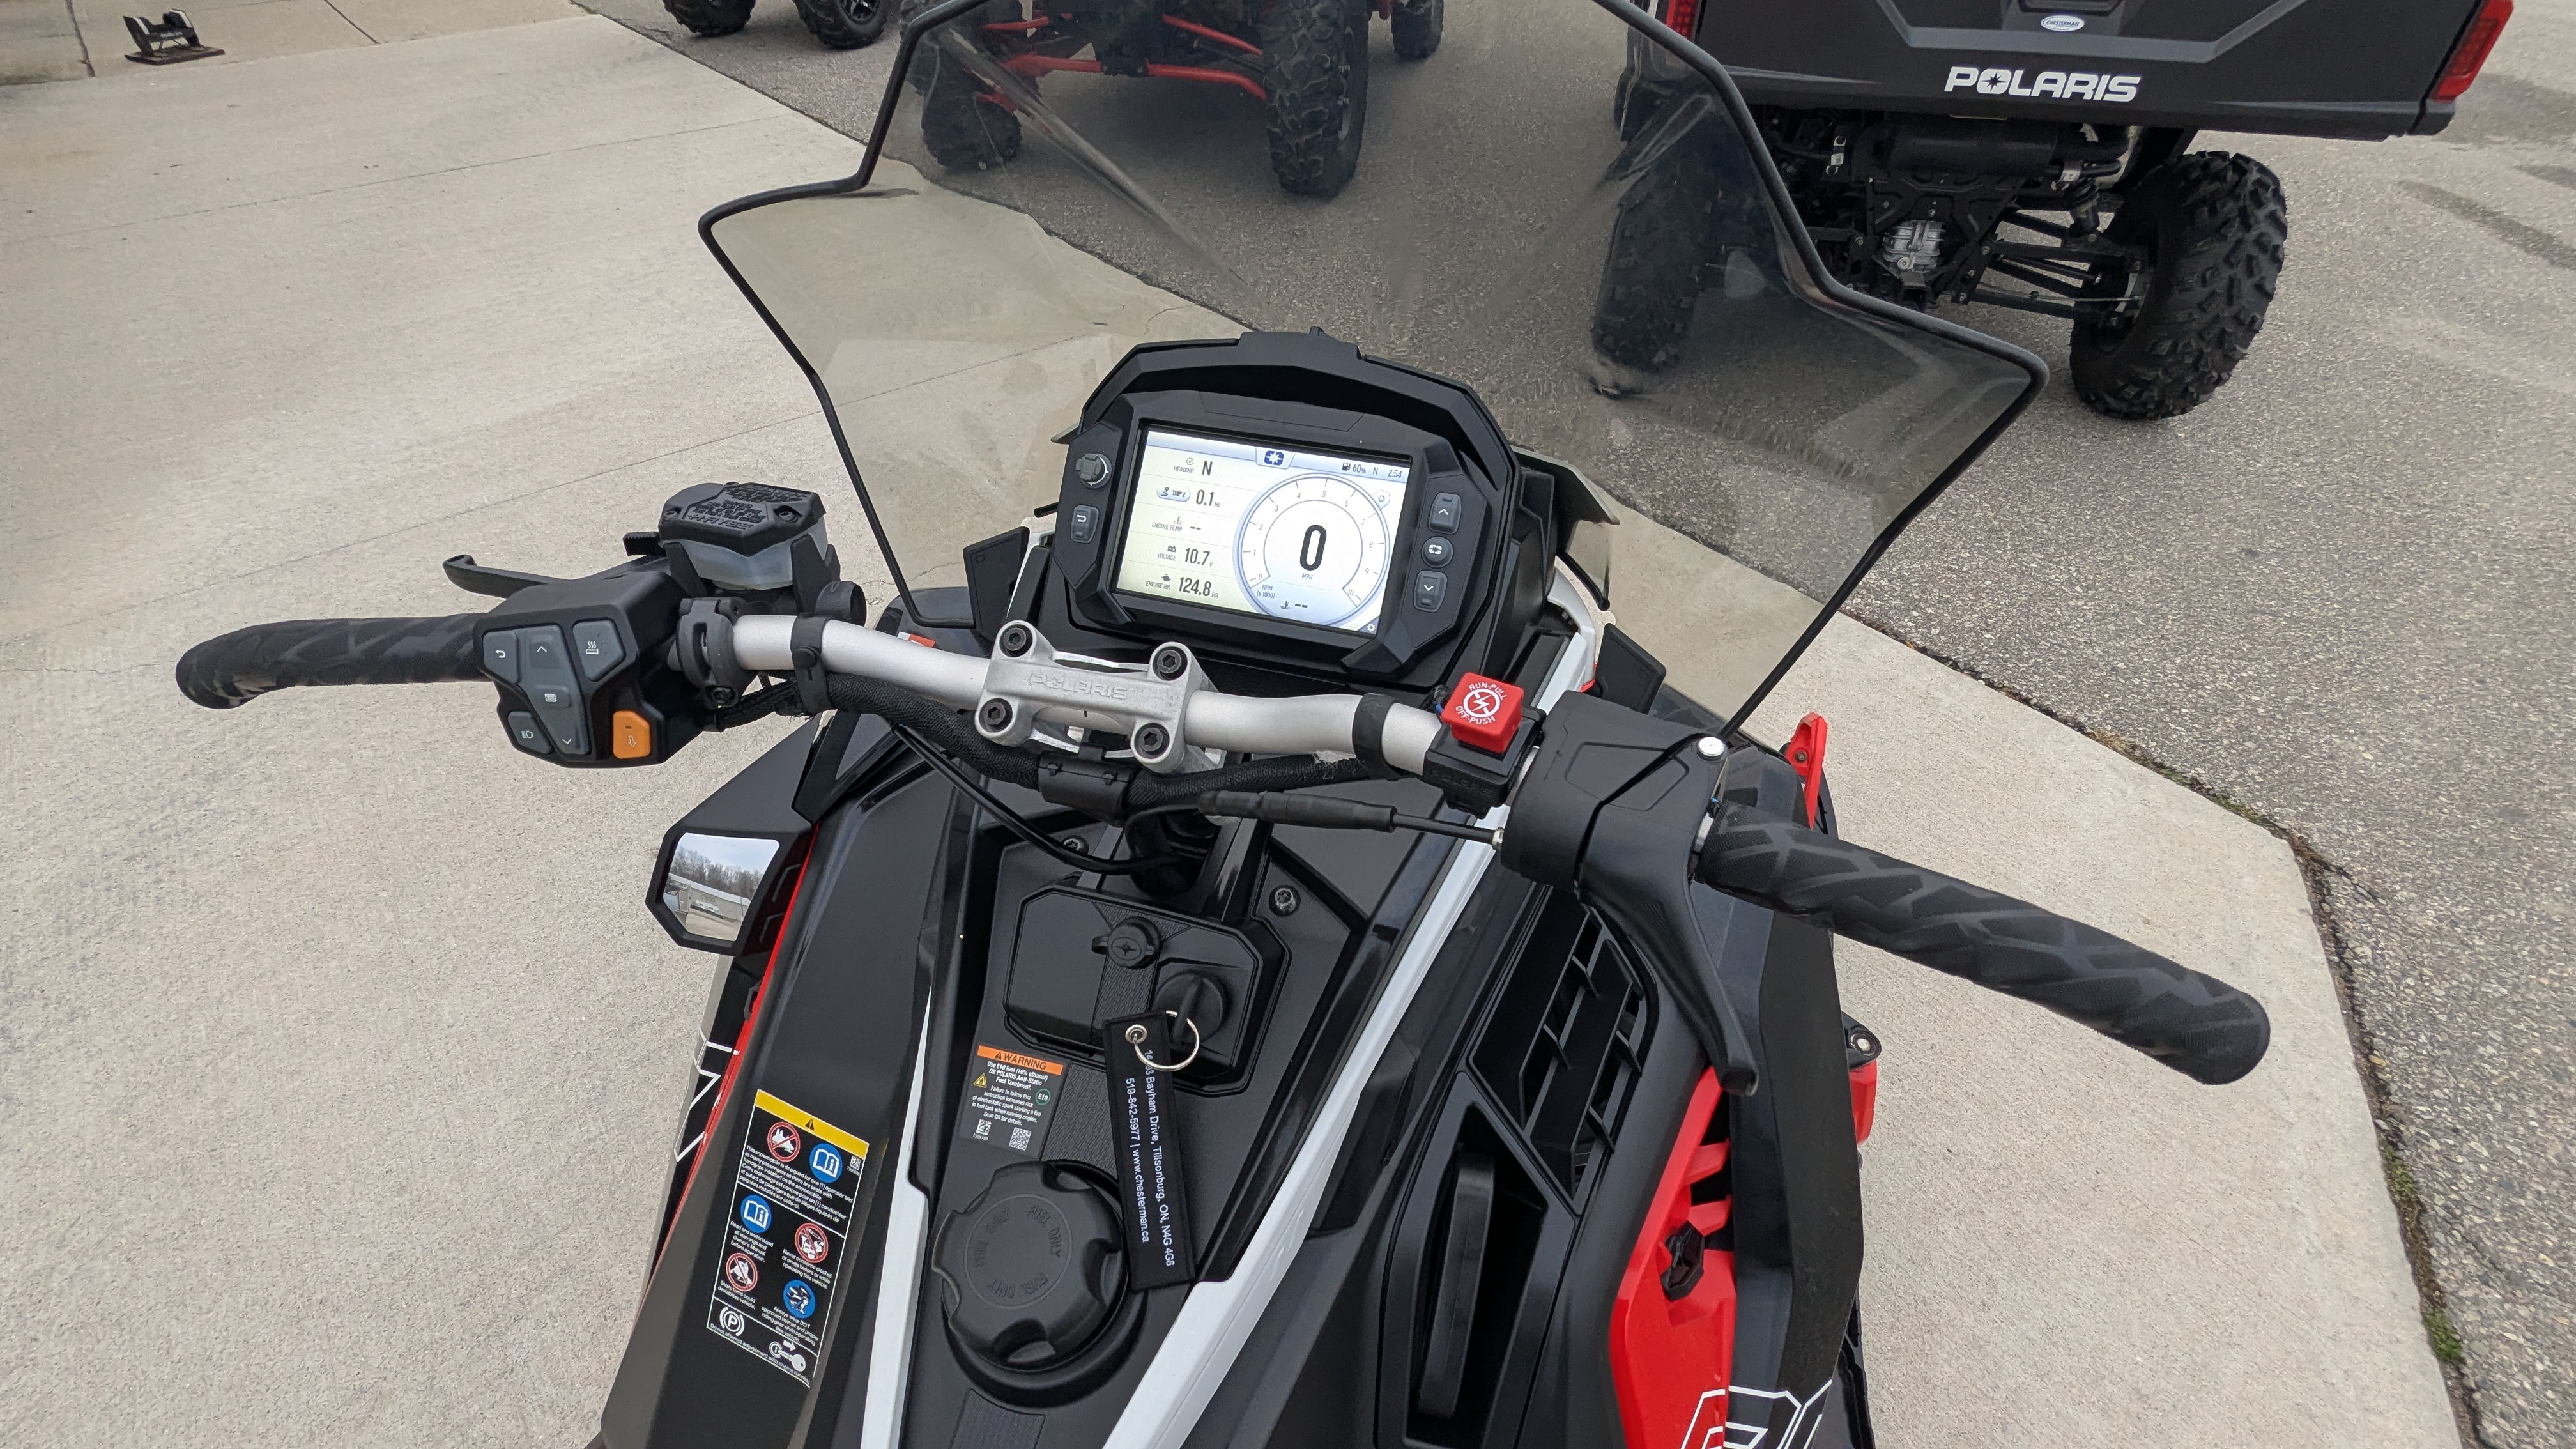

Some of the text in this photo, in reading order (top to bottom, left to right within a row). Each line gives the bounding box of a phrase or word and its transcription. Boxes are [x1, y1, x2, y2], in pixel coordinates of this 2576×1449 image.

[1944, 66, 2142, 102] POLARIS
[1173, 460, 1213, 476] HEADING N
[1353, 464, 1366, 474] 60%
[1388, 469, 1402, 479] 2:54
[1196, 489, 1214, 506] 0.1
[1151, 521, 1169, 530] ENGINE
[1300, 524, 1327, 571] 0
[1157, 548, 1211, 566] VOLTAGE 10.7
[1146, 580, 1163, 589] ENGINE
[1179, 576, 1212, 597] 124.8
[1262, 591, 1275, 599] 1000)
[1029, 673, 1128, 700] POLARIS
[1468, 682, 1507, 701] RUN-PULL
[1004, 1052, 1047, 1071] WARNING
[997, 1070, 1016, 1079] POLARIS
[1016, 1075, 1042, 1085] Anti-Static
[1008, 1079, 1031, 1090] Treatment.
[1029, 1072, 1048, 1081] ethanol)
[977, 1096, 1002, 1106] electrostatic
[1014, 1106, 1030, 1114] starting
[984, 1091, 1005, 1100] instruction
[1006, 1096, 1025, 1105] increases
[1006, 1111, 1022, 1119] running
[1126, 1077, 1149, 1243] 519-842-5977 www.chesterman.ca
[1145, 1050, 1175, 1266] 1493 Bayham Drive, Tillsonburg, ON, N4G 4G8
[1027, 1205, 1062, 1259] FUEL ONLY
